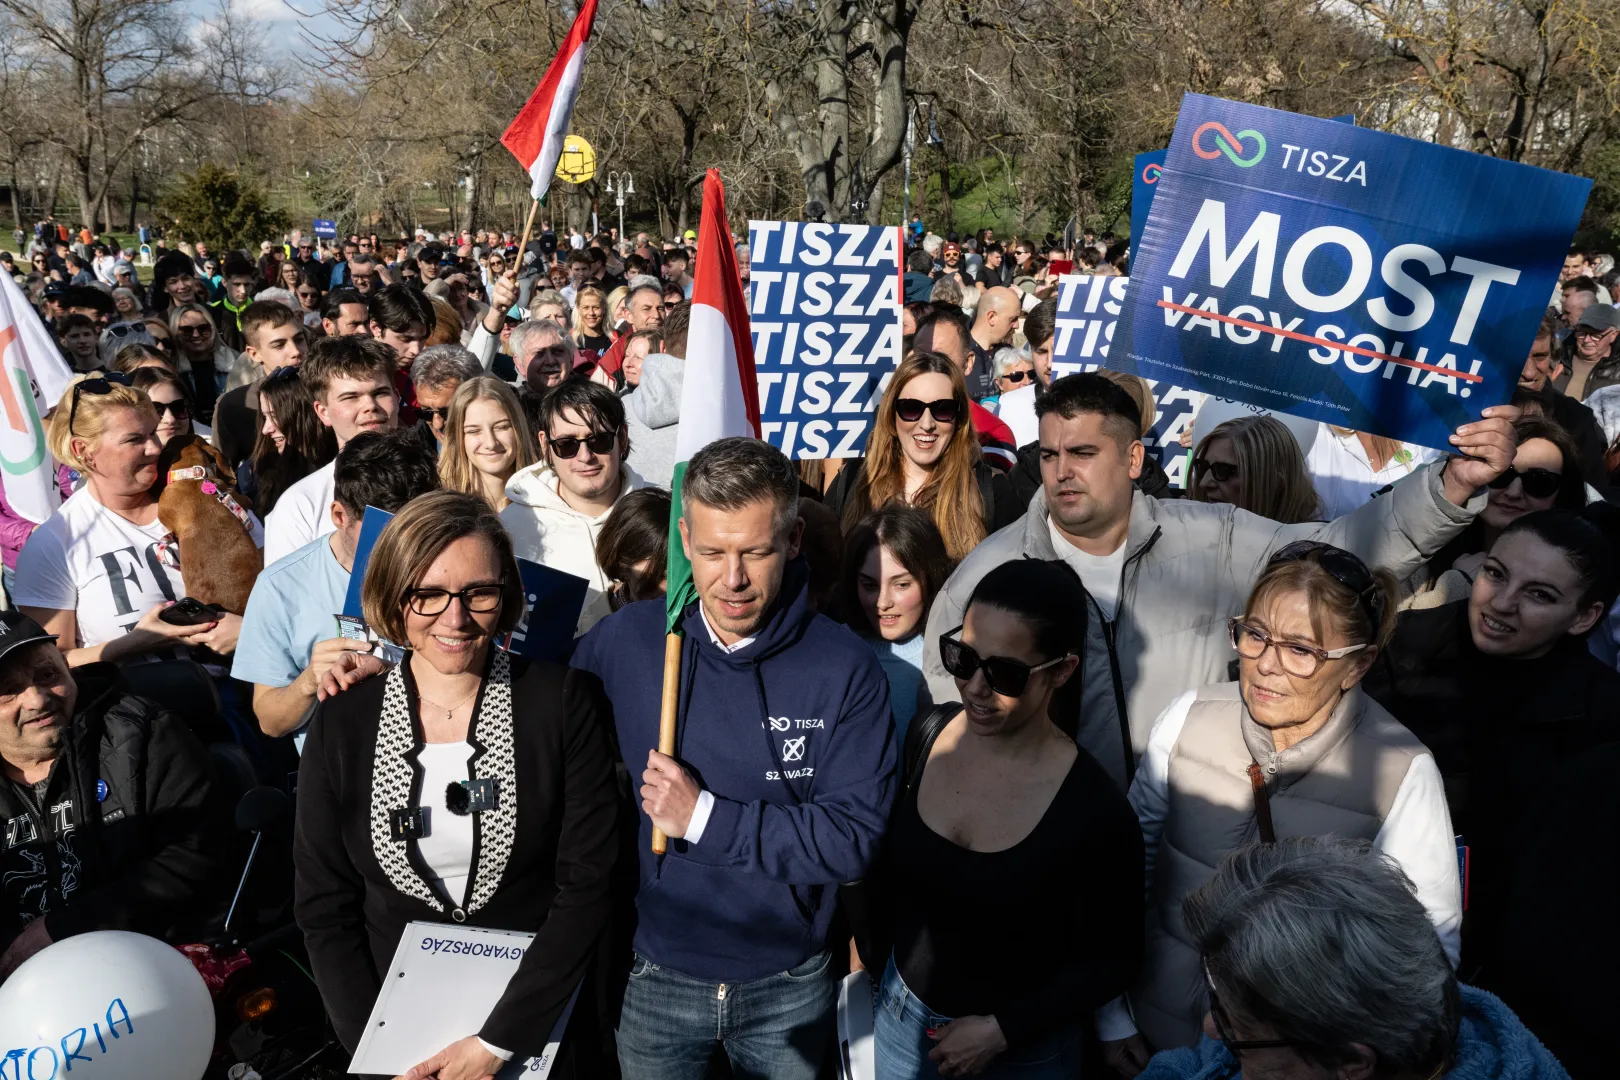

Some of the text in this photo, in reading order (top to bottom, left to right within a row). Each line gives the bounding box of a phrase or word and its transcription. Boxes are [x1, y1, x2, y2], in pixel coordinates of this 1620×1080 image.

[1281, 143, 1367, 187] TISZA
[749, 221, 898, 268] TISZA
[750, 271, 898, 316] TISZA
[1167, 198, 1522, 346] MOST
[1058, 275, 1130, 315] TIS
[751, 321, 898, 366] TISZA
[1162, 286, 1304, 353] VAGY
[1308, 324, 1483, 398] SOHA!
[762, 419, 866, 460] TISZ
[794, 719, 825, 730] TISZA
[420, 937, 526, 961] GYARORSZÁG
